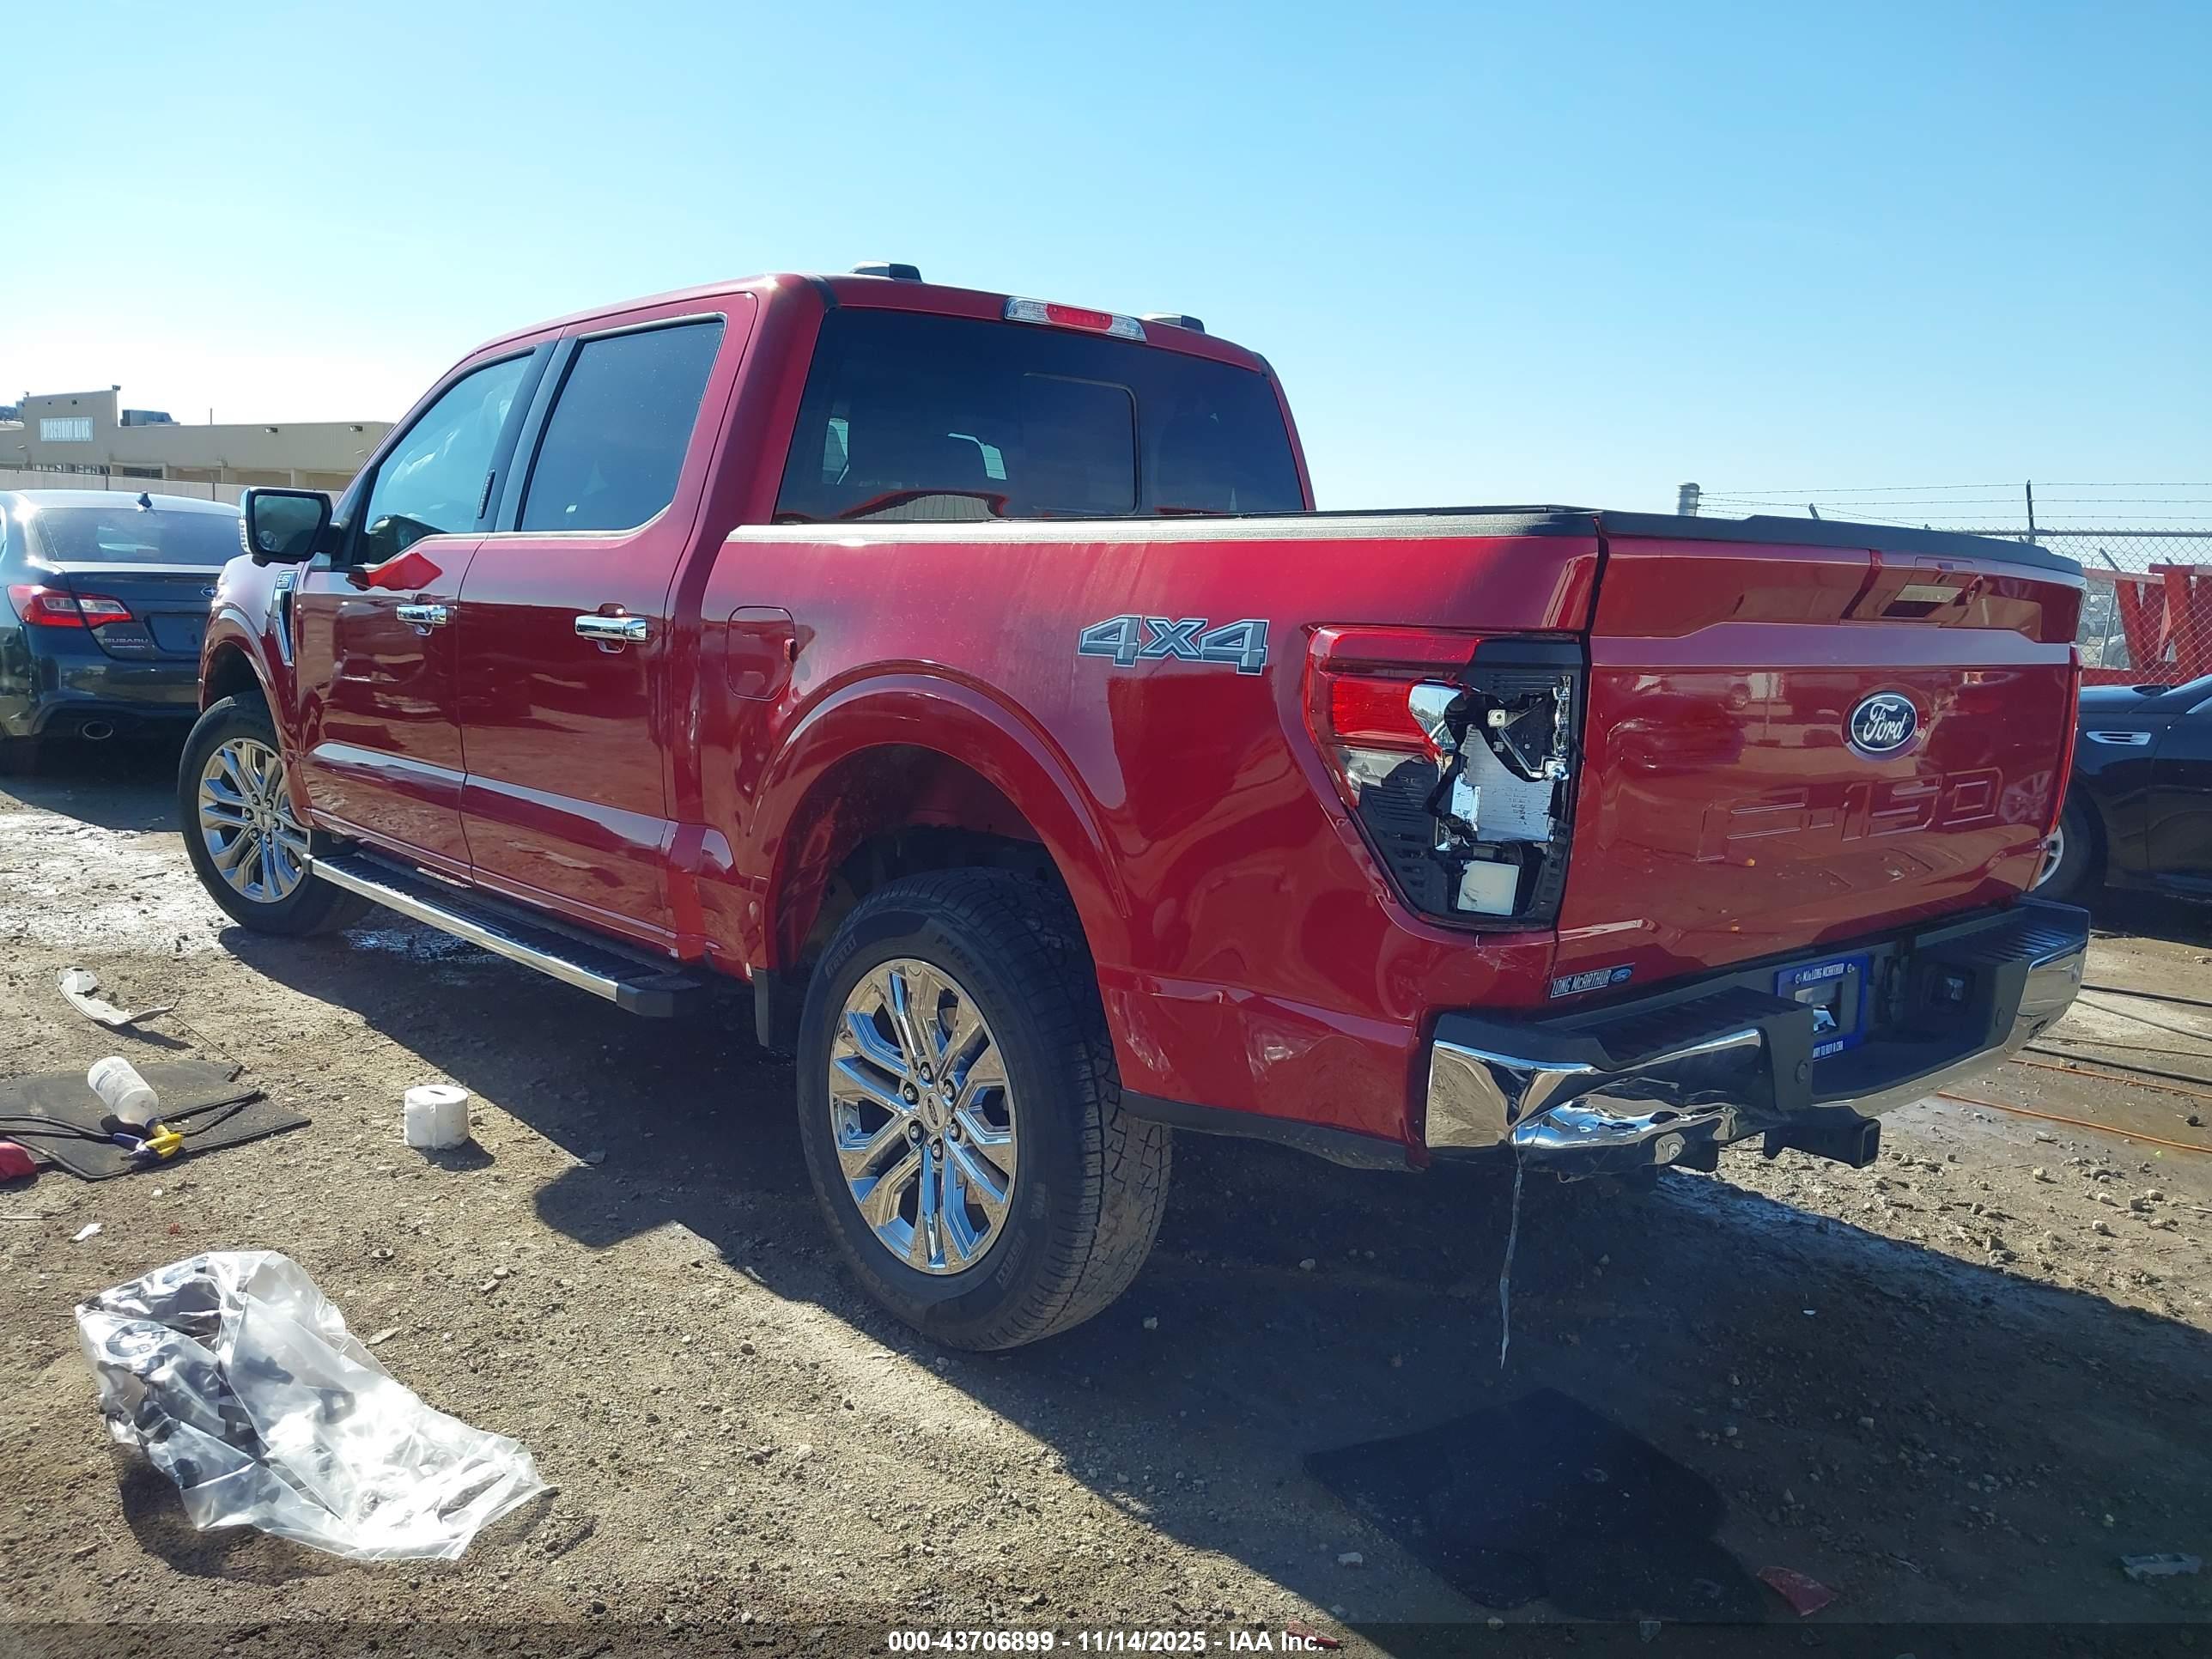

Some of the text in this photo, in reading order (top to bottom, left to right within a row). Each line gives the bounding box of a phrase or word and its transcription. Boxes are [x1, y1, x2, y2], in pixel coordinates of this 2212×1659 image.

[1078, 614, 1270, 676] 4X4
[1863, 702, 1908, 742] Ford
[1553, 977, 1572, 995] LONG
